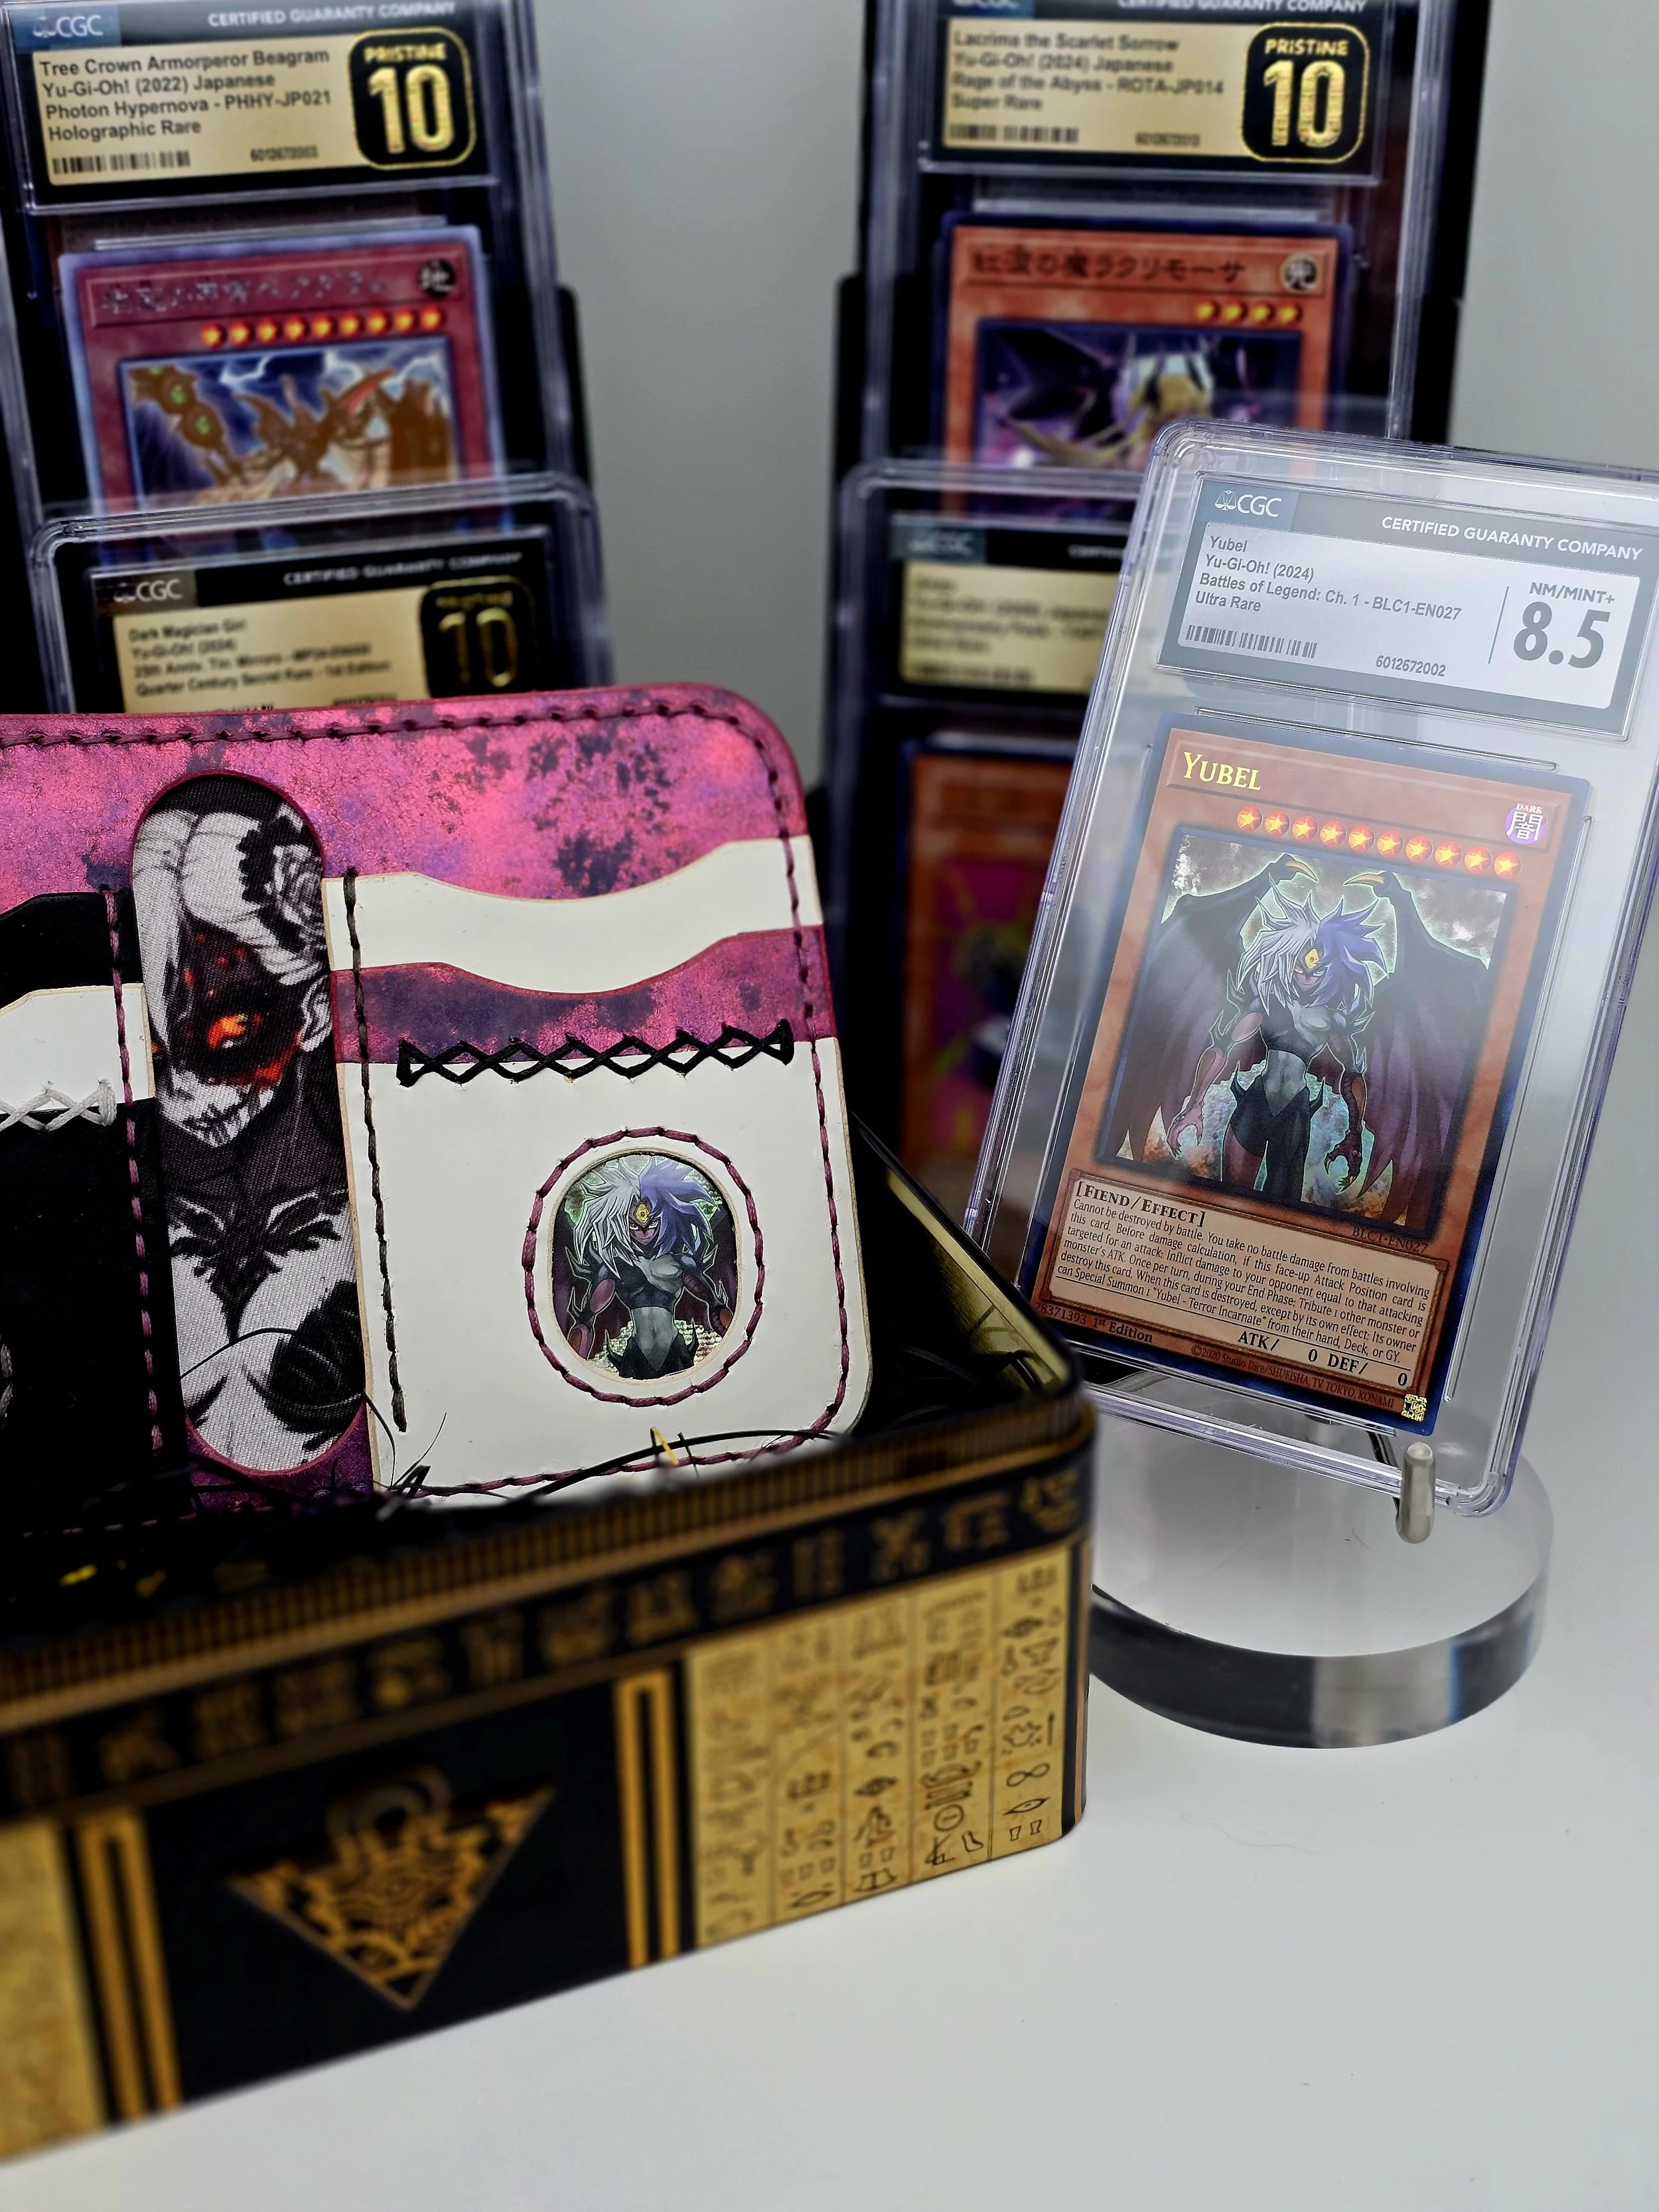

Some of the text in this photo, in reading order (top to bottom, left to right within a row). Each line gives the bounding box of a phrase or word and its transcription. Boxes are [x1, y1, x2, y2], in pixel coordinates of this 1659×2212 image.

[56, 15, 104, 38] CGC
[208, 1, 457, 27] CERTIFIED GUARANTY COMPANY
[1025, 34, 1051, 48] the
[1056, 33, 1114, 49] Scarlet
[1119, 35, 1180, 51] Sorrow
[1264, 38, 1349, 56] PRISTINE
[39, 50, 330, 76] Tree Crown Armorperor Beagram
[42, 75, 275, 98] Yu-Gi-Oh! (2022) Japanese
[952, 73, 994, 90] Rage
[1019, 76, 1045, 90] the
[1049, 76, 1102, 94] Abyss
[45, 90, 330, 119] Photon Hypernova PHHY-JP021
[368, 64, 454, 153] 10
[1263, 60, 1344, 147] 10
[48, 119, 201, 143] Holographic Rare
[1237, 494, 1281, 517] CGC
[1210, 535, 1248, 554] Yubel
[1382, 516, 1643, 560] CERTIFIED GUARANTY COMPANY
[1204, 553, 1314, 585] Yu-Gi-Oh! (2024)
[136, 579, 182, 601] CGC
[1194, 589, 1262, 612] Ultra Rare
[1199, 570, 1462, 621] Battles of Legend: Ch. 1 BLC1-EN027
[1529, 581, 1615, 604] NM/MINT+
[439, 607, 518, 688] 10
[1513, 601, 1611, 669] 8.5
[1376, 655, 1446, 677] 6012672002
[1516, 803, 1543, 814] DARK
[1506, 810, 1544, 842] 闇
[1071, 1212, 1086, 1224] this
[1090, 1219, 1110, 1231] card.
[1116, 1223, 1145, 1239] Before
[1149, 1231, 1183, 1253] damage
[1187, 1243, 1237, 1265] calculation,
[1254, 1258, 1271, 1272] this
[1275, 1263, 1310, 1284] face-up
[1314, 1271, 1345, 1290] Attack
[1349, 1282, 1387, 1301] Position
[1392, 1295, 1414, 1307] card
[1074, 1199, 1429, 1299] Cannot be destroyed by battle. You take no battle damage from battles involving
[1064, 1240, 1106, 1258] monster's
[1107, 1249, 1125, 1262] ATK.
[1129, 1254, 1151, 1269] Once
[1152, 1263, 1169, 1273] per
[1171, 1266, 1190, 1281] turn,
[1194, 1270, 1223, 1290] during
[1224, 1281, 1246, 1293] your
[1247, 1284, 1265, 1298] End
[1266, 1289, 1296, 1306] Phase:
[1299, 1297, 1332, 1315] Tribute
[1340, 1310, 1366, 1323] other
[1368, 1318, 1407, 1334] monster
[1068, 1226, 1423, 1327] targeted for an attack: Inflict damage to your opponent equal to that attacking
[1058, 1266, 1073, 1276] can
[1074, 1268, 1106, 1285] Special
[1106, 1276, 1144, 1295] Summon
[1189, 1297, 1217, 1313] Terror
[1267, 1317, 1289, 1333] from
[1292, 1324, 1314, 1339] their
[1315, 1329, 1340, 1348] hand,
[1344, 1338, 1368, 1355] Deck,
[1372, 1349, 1384, 1357] or
[1386, 1349, 1400, 1362] GY.
[1061, 1251, 1094, 1270] destroy
[1095, 1260, 1111, 1272] this
[1112, 1266, 1132, 1279] card.
[1137, 1269, 1161, 1286] When
[1163, 1277, 1179, 1290] this
[1181, 1284, 1201, 1295] card
[1211, 1290, 1257, 1313] destroyed,
[1260, 1305, 1292, 1321] except
[1292, 1310, 1305, 1325] by
[1305, 1314, 1317, 1326] its
[1319, 1320, 1338, 1332] own
[1340, 1324, 1370, 1340] effect:
[1372, 1331, 1384, 1344] Its
[1386, 1338, 1416, 1352] owner
[1093, 1317, 1153, 1343] 1st Edition
[1237, 1330, 1407, 1386] ATK/ 0 DEF/ 0
[1222, 1353, 1246, 1368] Studio
[1312, 1378, 1324, 1388] TV
[1326, 1382, 1356, 1398] TOKYO,
[1358, 1390, 1394, 1408] KONAMI
